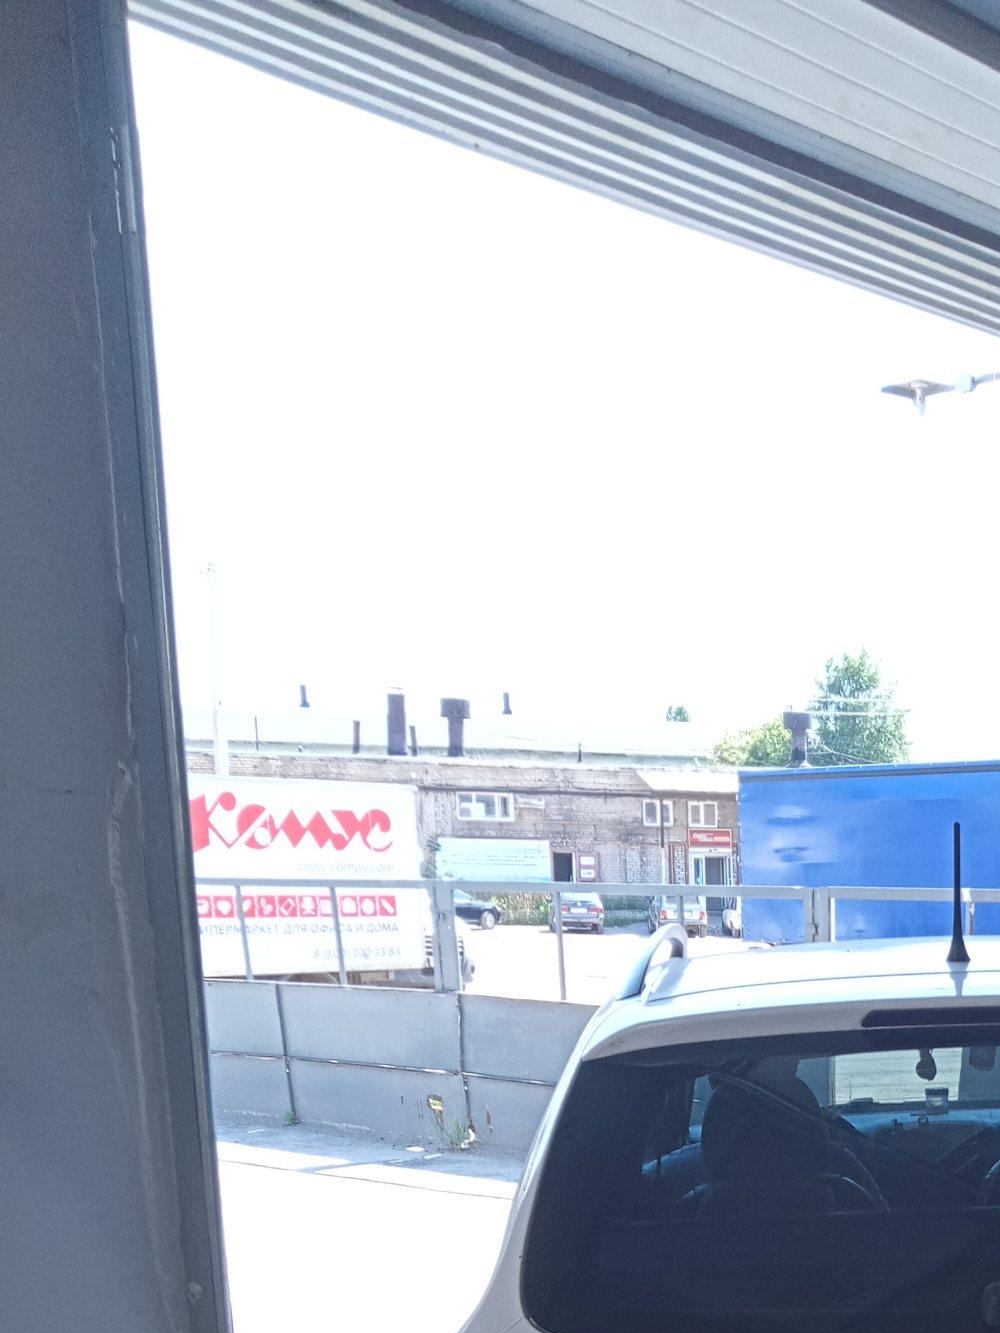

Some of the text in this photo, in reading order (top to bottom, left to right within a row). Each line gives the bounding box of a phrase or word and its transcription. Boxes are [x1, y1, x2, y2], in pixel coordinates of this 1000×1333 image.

[189, 791, 393, 852] Комус
[200, 924, 278, 935] ИПЕРМАРКЕТ
[367, 923, 399, 933] ДОМА
